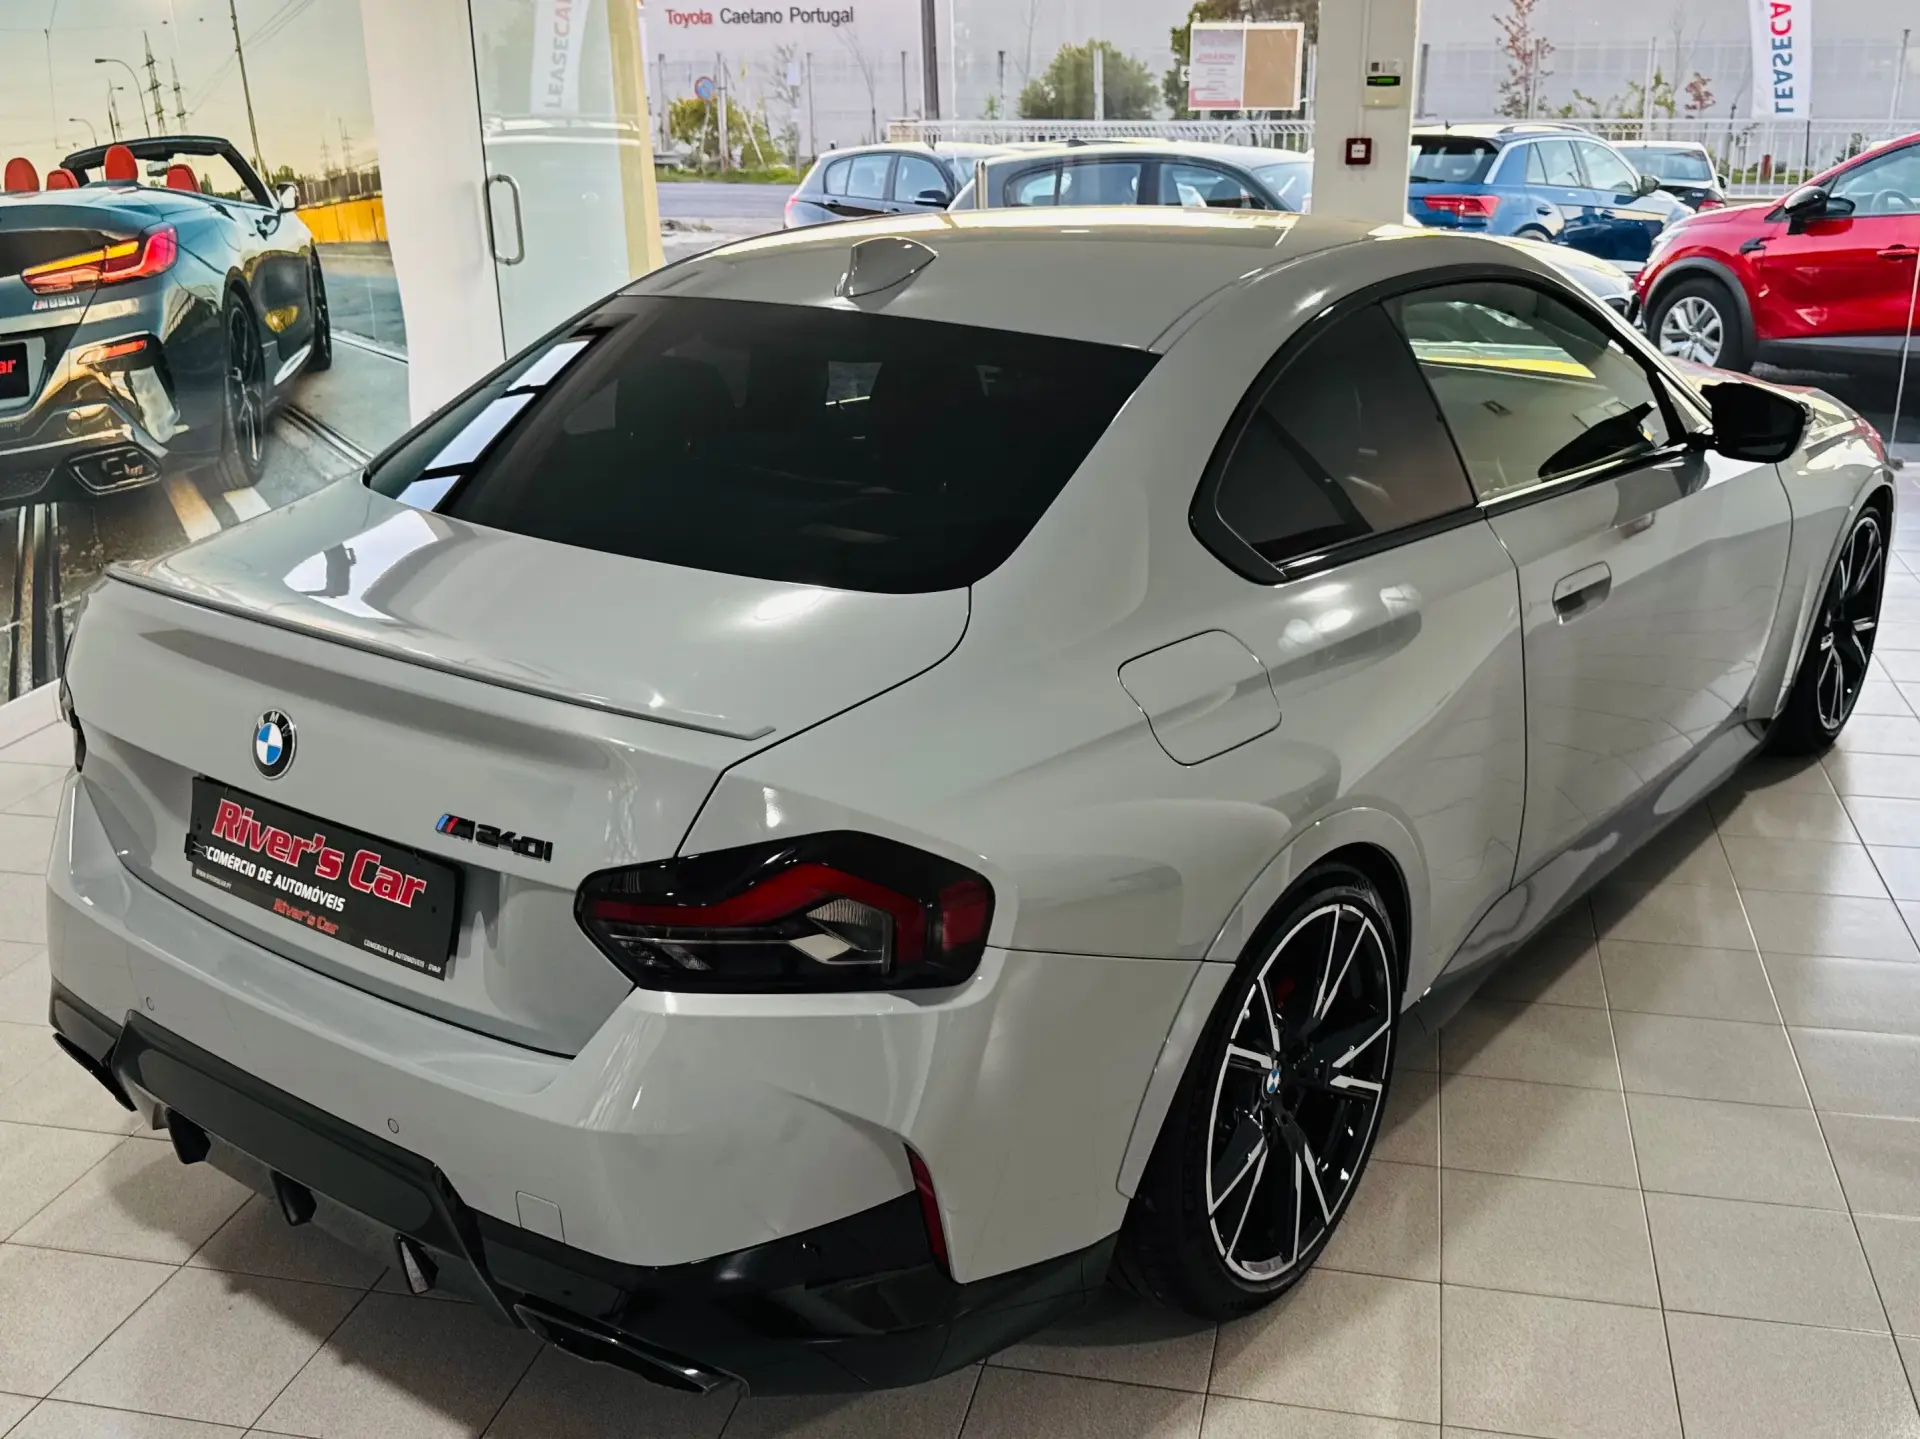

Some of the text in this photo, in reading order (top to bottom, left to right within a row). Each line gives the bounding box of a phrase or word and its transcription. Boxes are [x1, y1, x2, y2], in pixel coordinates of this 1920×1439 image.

[666, 7, 854, 28] Toyota Caetano Portugal
[543, 0, 572, 108] LEASECA
[206, 846, 257, 878] COMÉRCIO
[257, 866, 274, 885] DE
[273, 874, 346, 912] AUTOMÓVEIS
[212, 798, 427, 908] River's Car
[316, 914, 339, 936] Car
